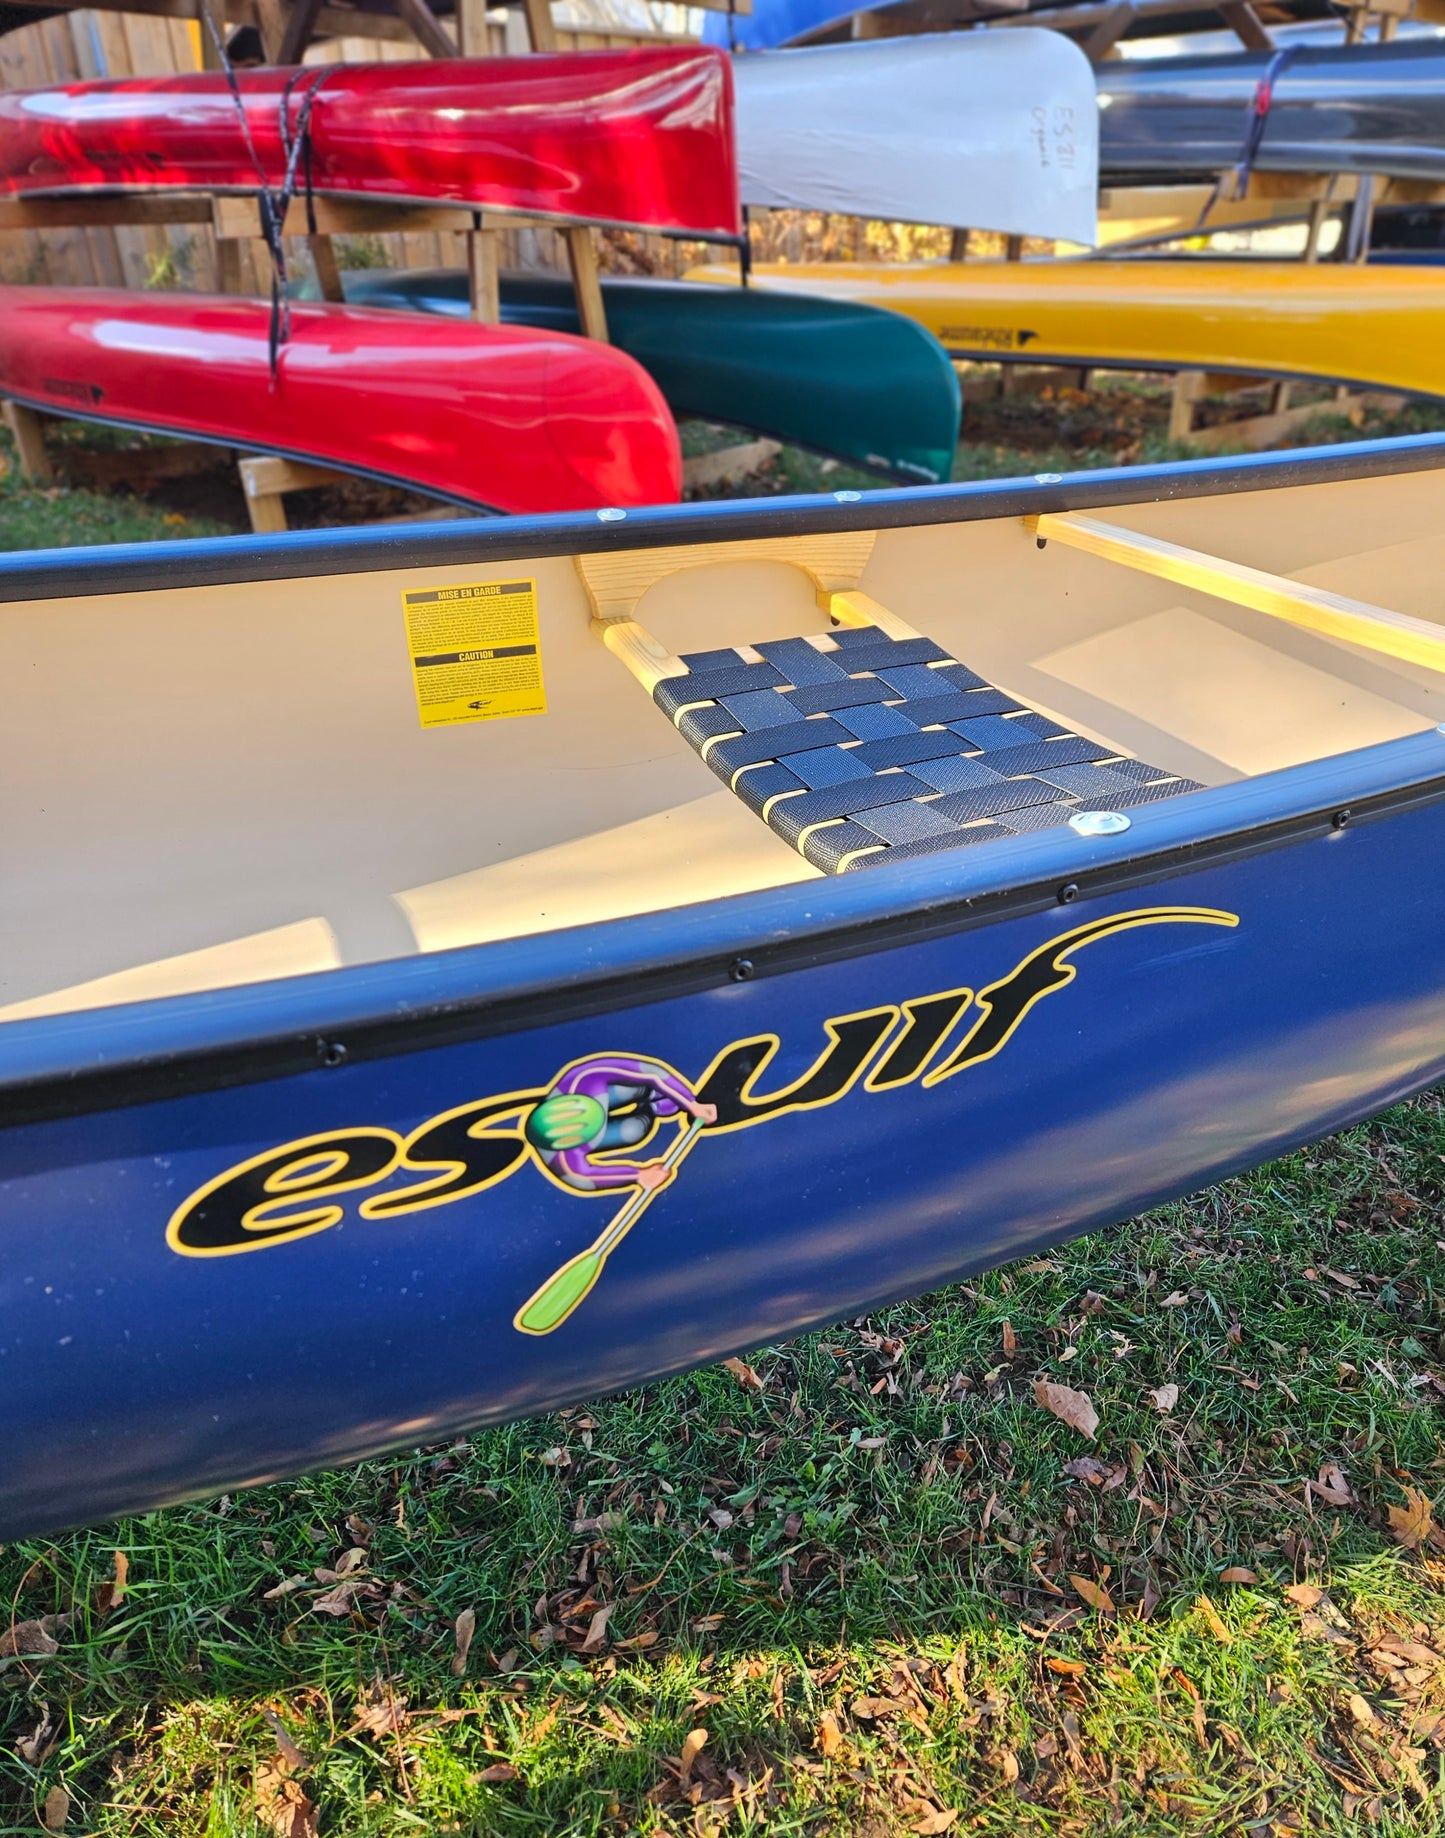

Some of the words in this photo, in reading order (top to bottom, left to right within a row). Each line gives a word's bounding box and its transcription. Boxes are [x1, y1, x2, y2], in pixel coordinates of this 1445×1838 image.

[438, 590, 460, 600] MISE
[461, 588, 472, 598] EN
[473, 586, 502, 597] GARDE
[458, 650, 495, 662] CAUTION
